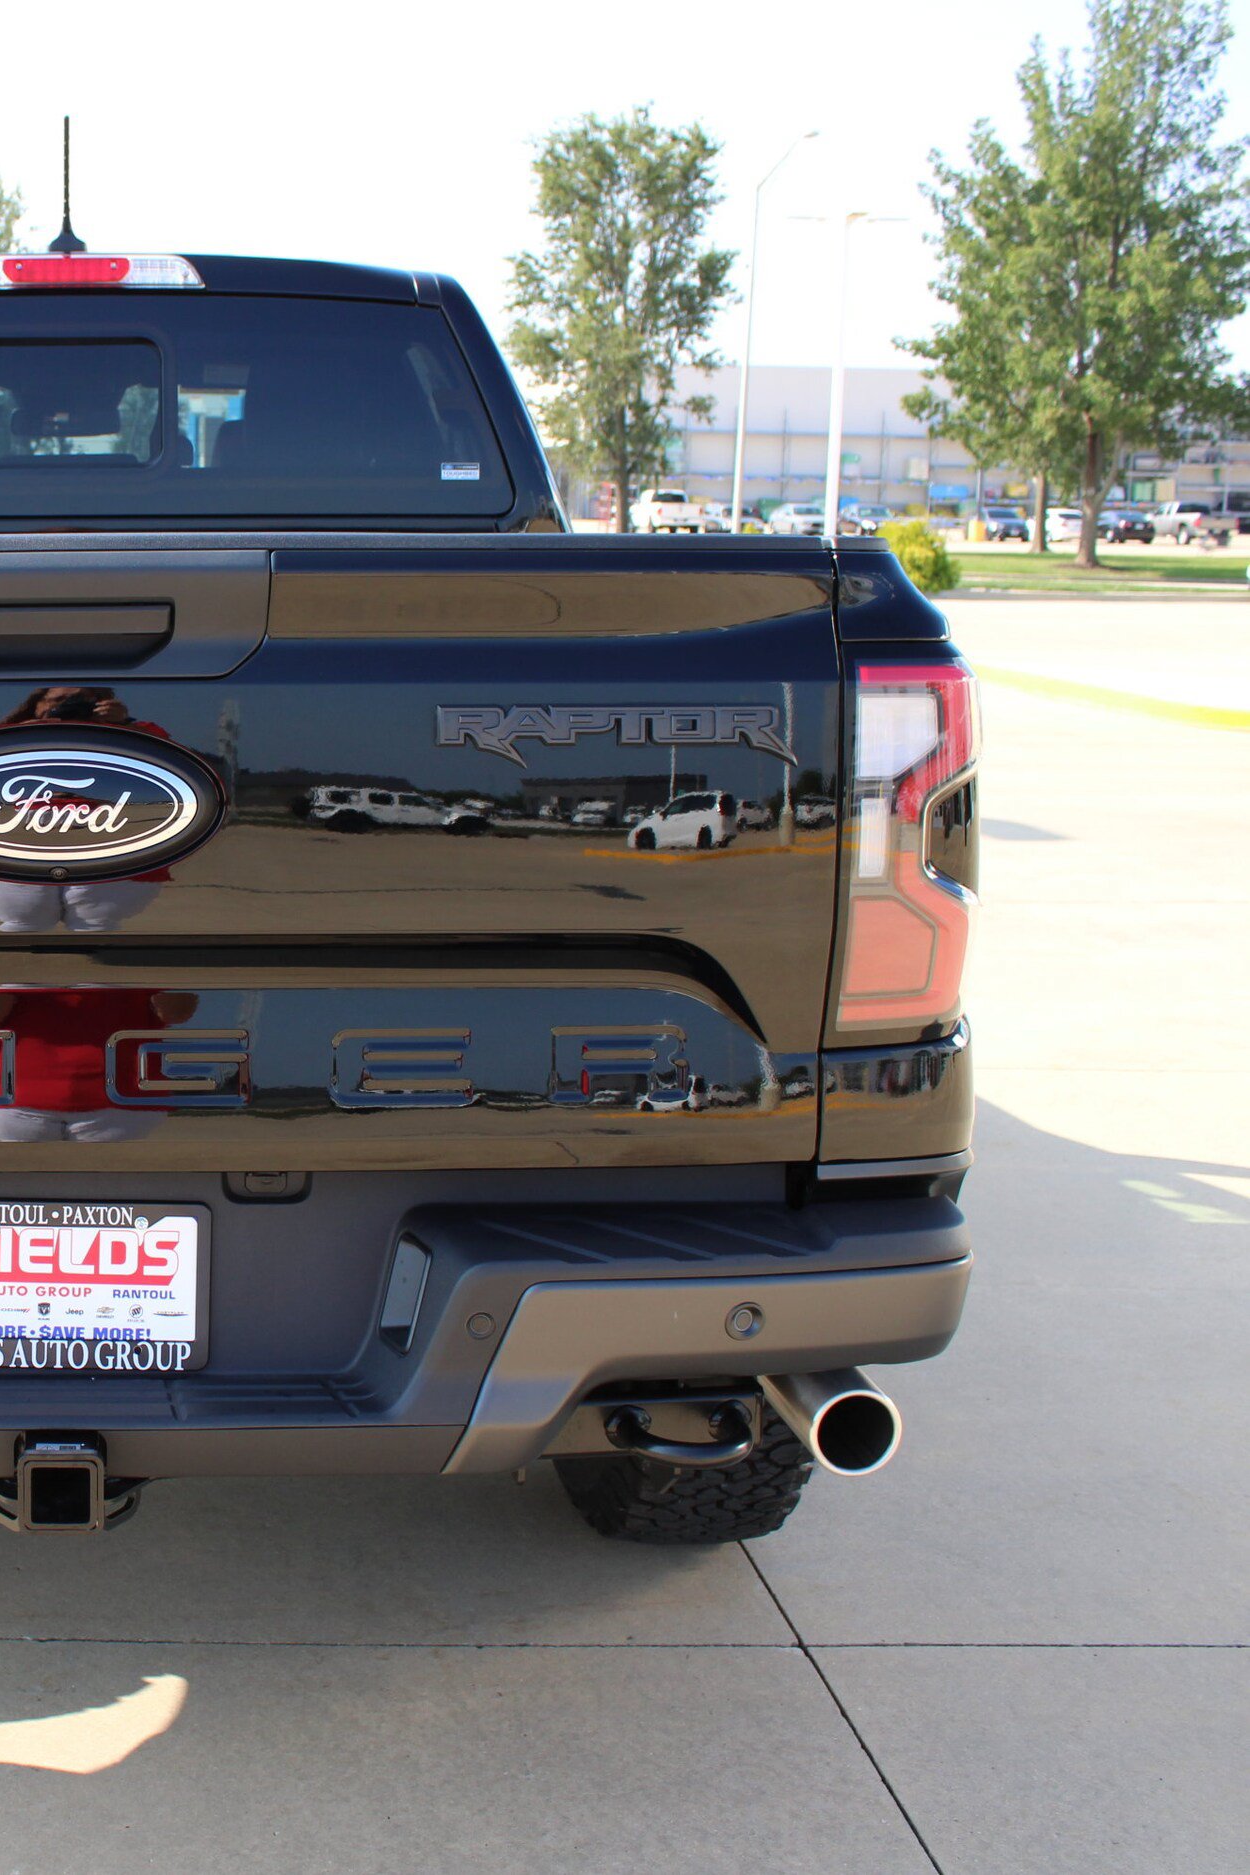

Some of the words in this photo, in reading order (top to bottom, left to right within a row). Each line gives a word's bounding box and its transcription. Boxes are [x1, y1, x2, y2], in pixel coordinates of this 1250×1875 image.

[436, 704, 798, 768] RAPTOR
[63, 1205, 133, 1226] PAXTON
[36, 1286, 92, 1298] GROUP
[113, 1289, 176, 1300] RANTOUL
[65, 1307, 84, 1316] Jeep
[93, 1327, 151, 1341] MORE!
[11, 1338, 88, 1369] AUTO
[95, 1340, 191, 1371] GROUP
